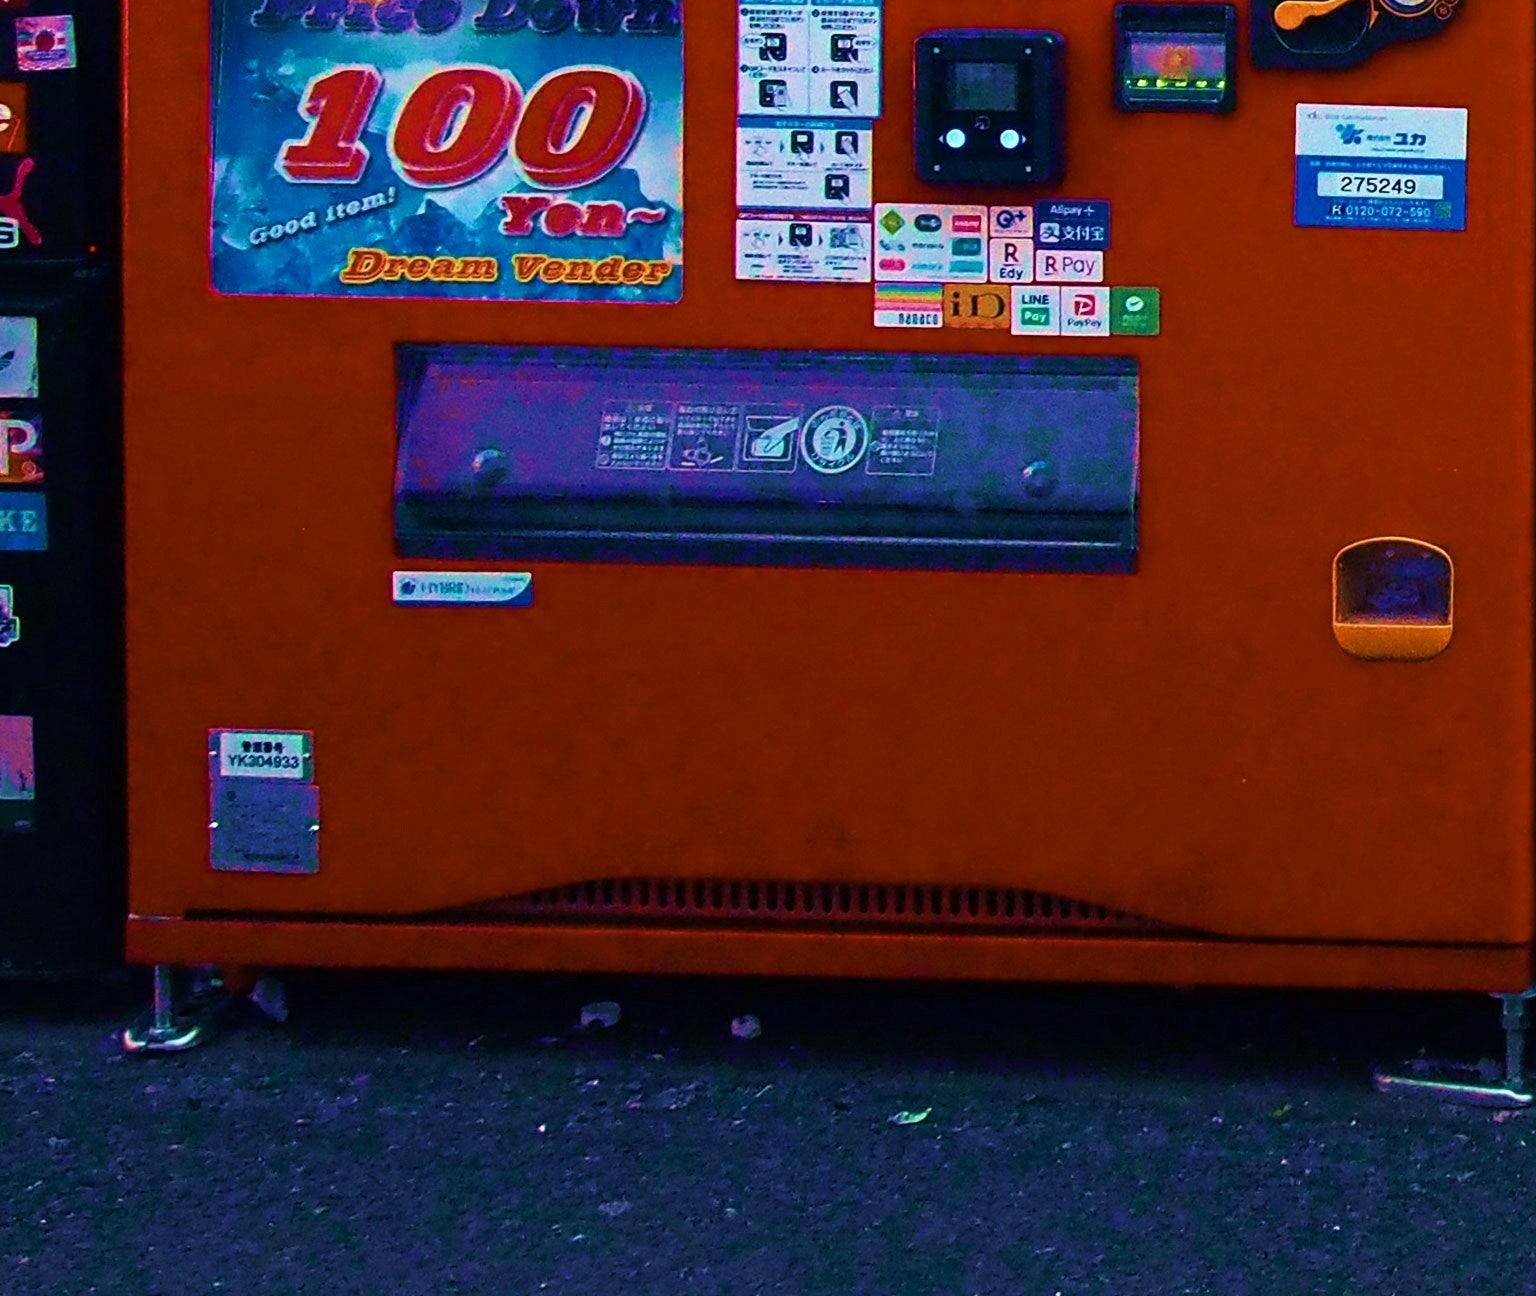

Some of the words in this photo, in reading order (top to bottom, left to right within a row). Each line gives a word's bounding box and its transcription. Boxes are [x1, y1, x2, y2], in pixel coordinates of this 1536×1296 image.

[275, 63, 648, 190] 100
[1340, 177, 1417, 196] 275249
[1346, 206, 1431, 218] 0120-072-590
[248, 211, 318, 248] Good
[340, 247, 497, 284] Dream
[514, 254, 673, 285] Vender
[1000, 268, 1023, 281] Edy
[1062, 256, 1096, 277] Pay
[1021, 294, 1050, 305] LINE
[1024, 310, 1046, 323] Pay
[228, 754, 300, 769] YK304933
